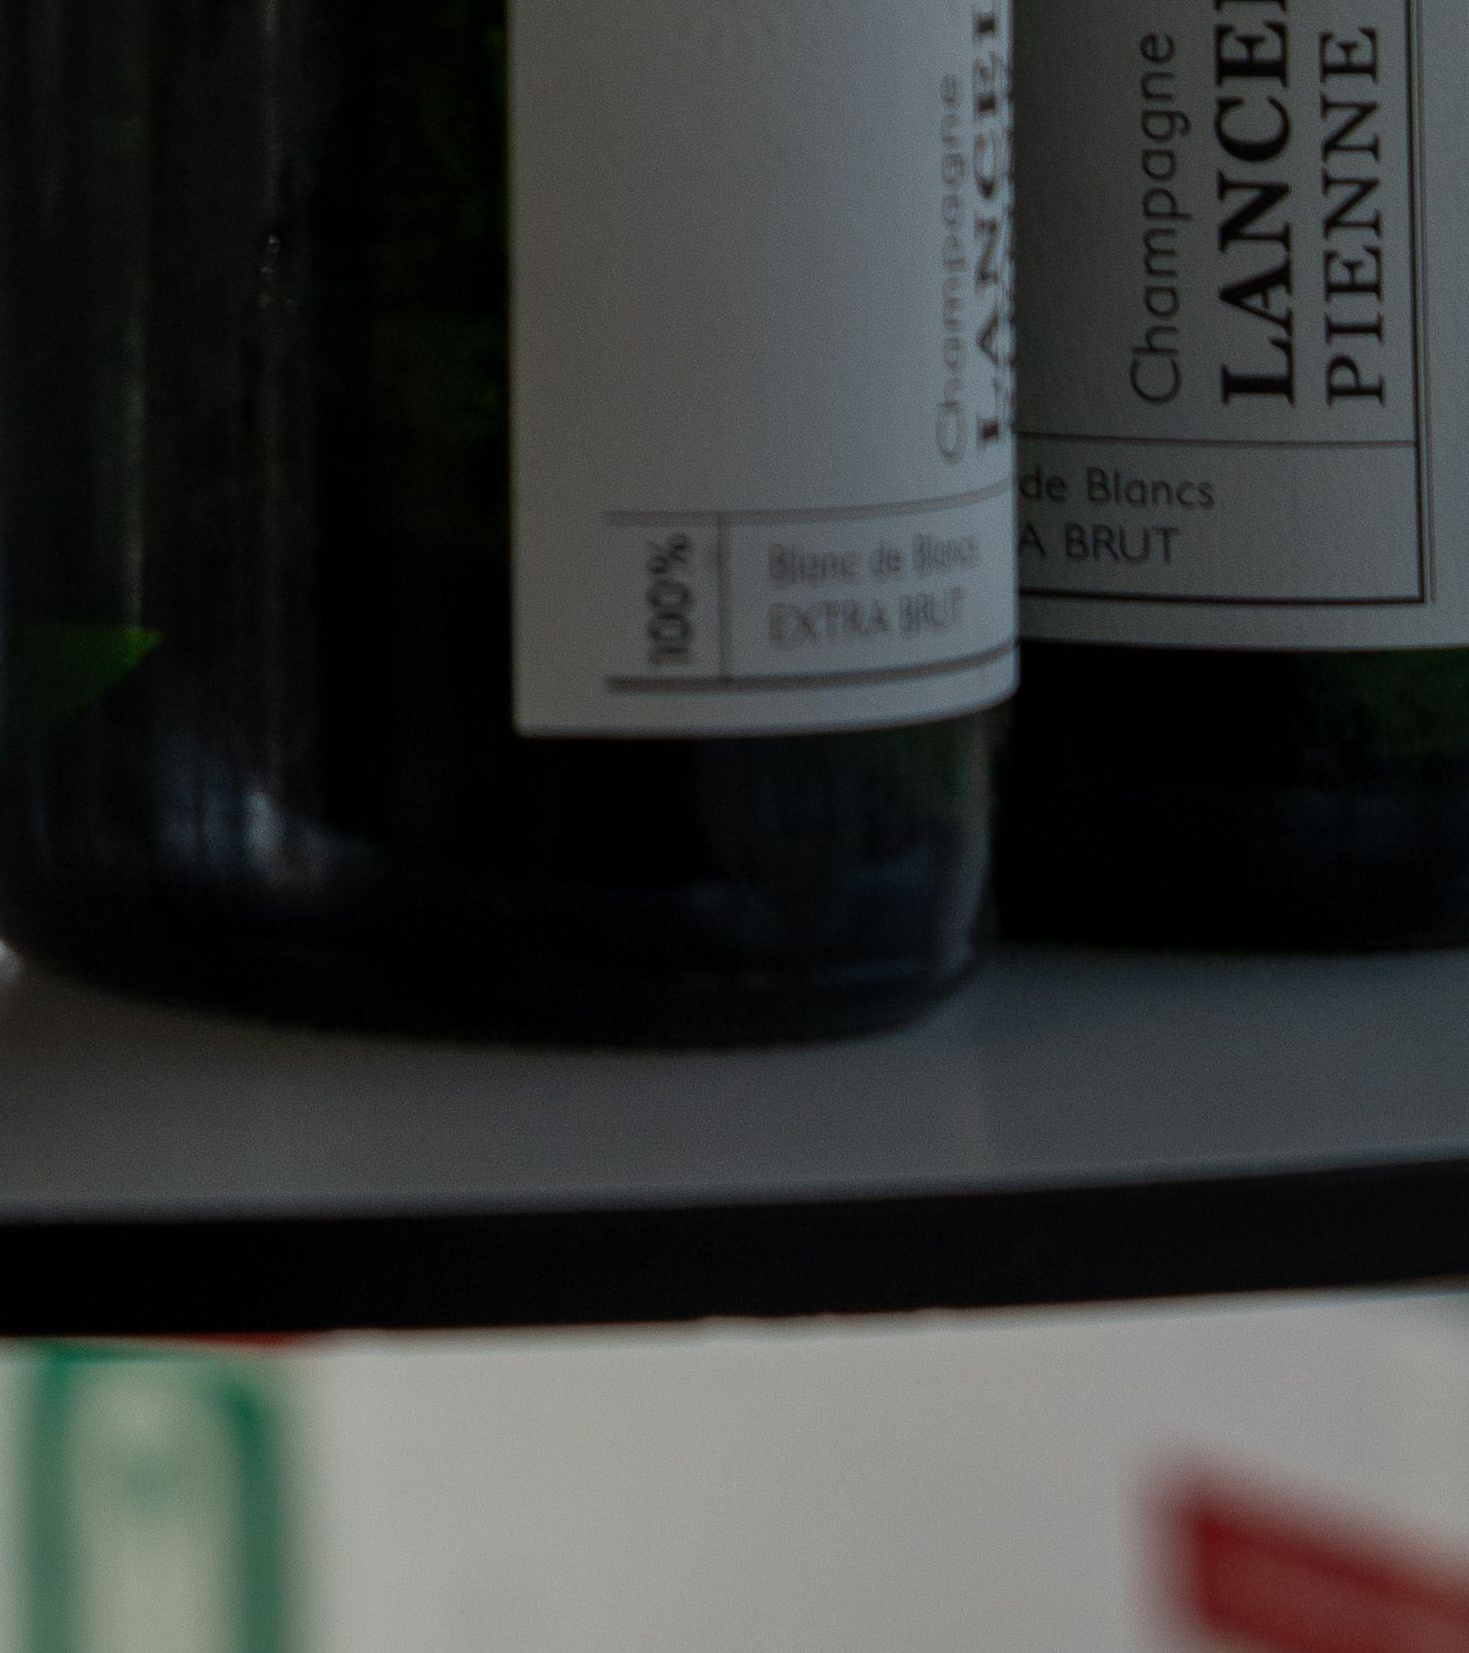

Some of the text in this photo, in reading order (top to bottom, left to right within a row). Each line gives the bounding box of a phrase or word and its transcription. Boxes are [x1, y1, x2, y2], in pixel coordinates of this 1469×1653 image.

[1129, 31, 1192, 405] Champagne
[1318, 26, 1386, 407] PIENNE
[935, 73, 968, 465] Champagne
[1020, 463, 1217, 510] de Blancs
[768, 542, 858, 588] Blanc
[868, 537, 904, 582] de
[1064, 522, 1181, 567] BRUT
[645, 531, 695, 668] 100%
[768, 586, 968, 651] EXTRA BRUT
